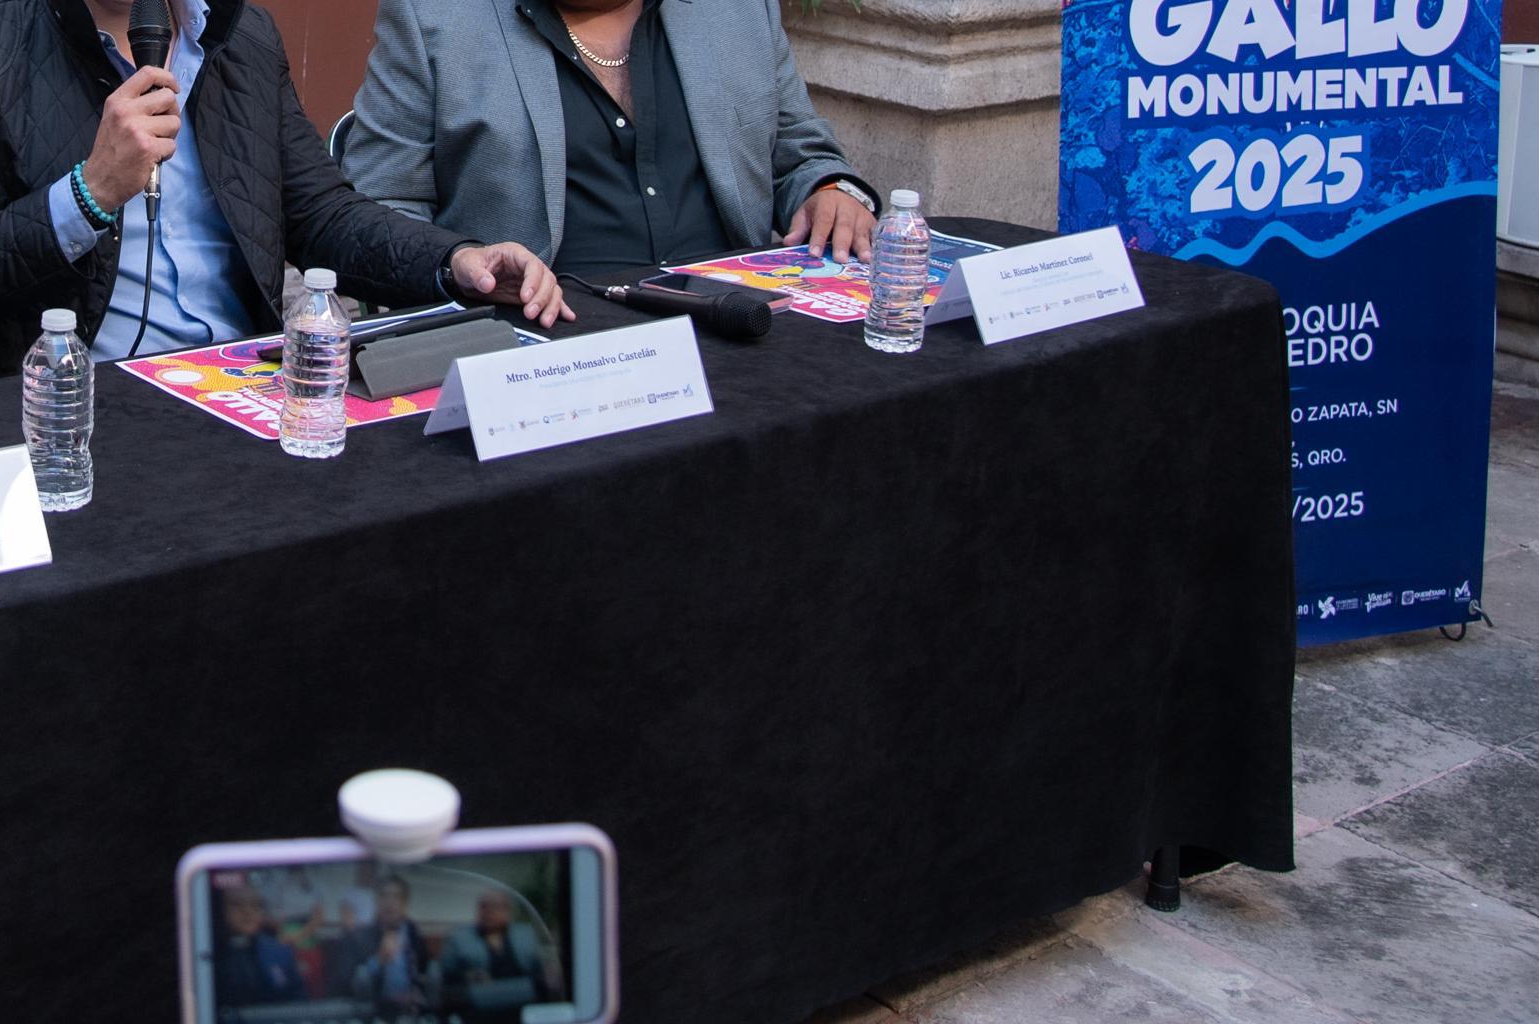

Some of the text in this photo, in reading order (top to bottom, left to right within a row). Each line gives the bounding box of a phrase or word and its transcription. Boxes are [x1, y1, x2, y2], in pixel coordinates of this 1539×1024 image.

[1127, 65, 1464, 120] MONUMENTAL
[1188, 133, 1364, 214] 2025
[1013, 264, 1039, 278] Ricardo
[1069, 252, 1094, 266] Coronel
[1282, 301, 1381, 335] OQUIA
[506, 370, 533, 384] Mtro.
[534, 364, 571, 380] Rodrigo
[573, 356, 617, 371] Monsalvo
[618, 347, 657, 363] Castelán
[1287, 334, 1375, 367] EDRO
[1307, 402, 1373, 423] ZAPATA,
[1376, 398, 1399, 414] SN
[1307, 448, 1347, 466] QRO.
[1292, 491, 1365, 523] /2025
